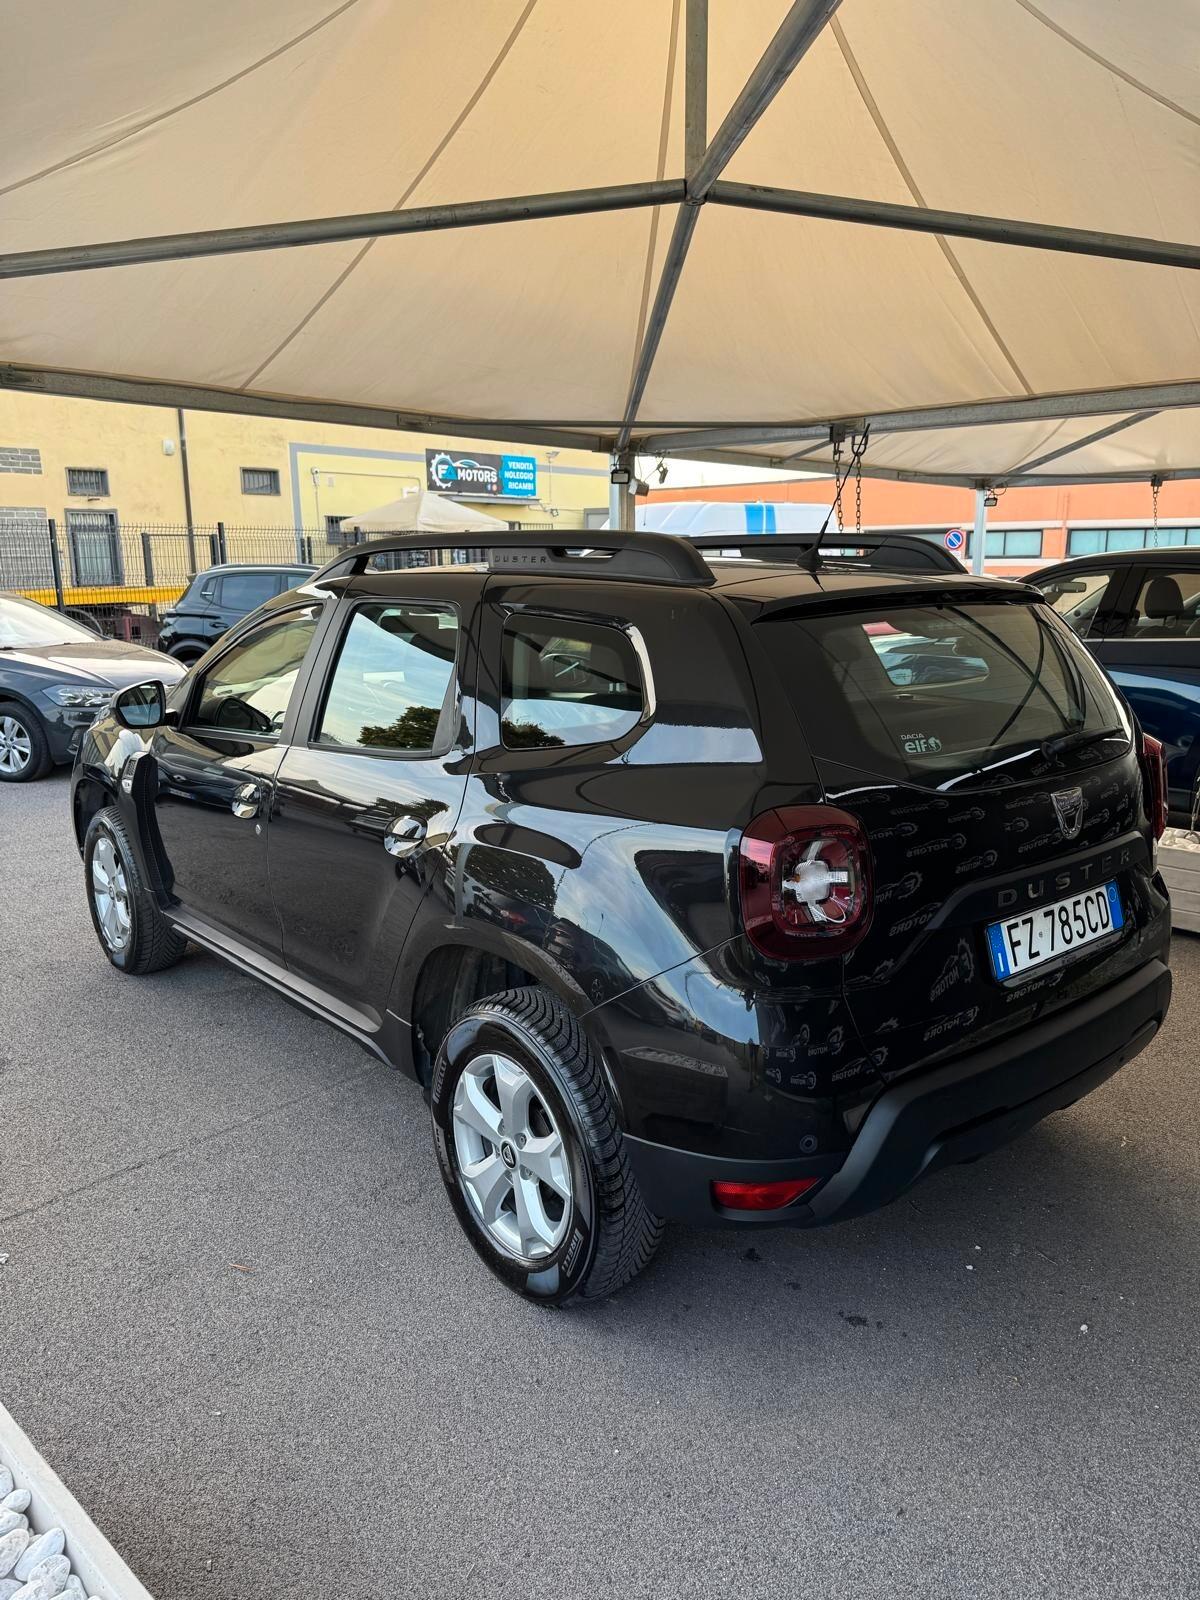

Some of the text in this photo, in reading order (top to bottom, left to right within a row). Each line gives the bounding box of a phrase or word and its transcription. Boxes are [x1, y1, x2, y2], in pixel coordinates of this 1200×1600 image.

[508, 461, 534, 470] VENDITA
[458, 468, 498, 483] MOTORS
[504, 471, 534, 480] NOLEGGIO
[508, 481, 534, 490] RICAMBI
[494, 555, 547, 563] DUSTER
[904, 739, 927, 753] elf
[997, 847, 1130, 908] DUSTER
[1007, 891, 1110, 967] FZ 785CD
